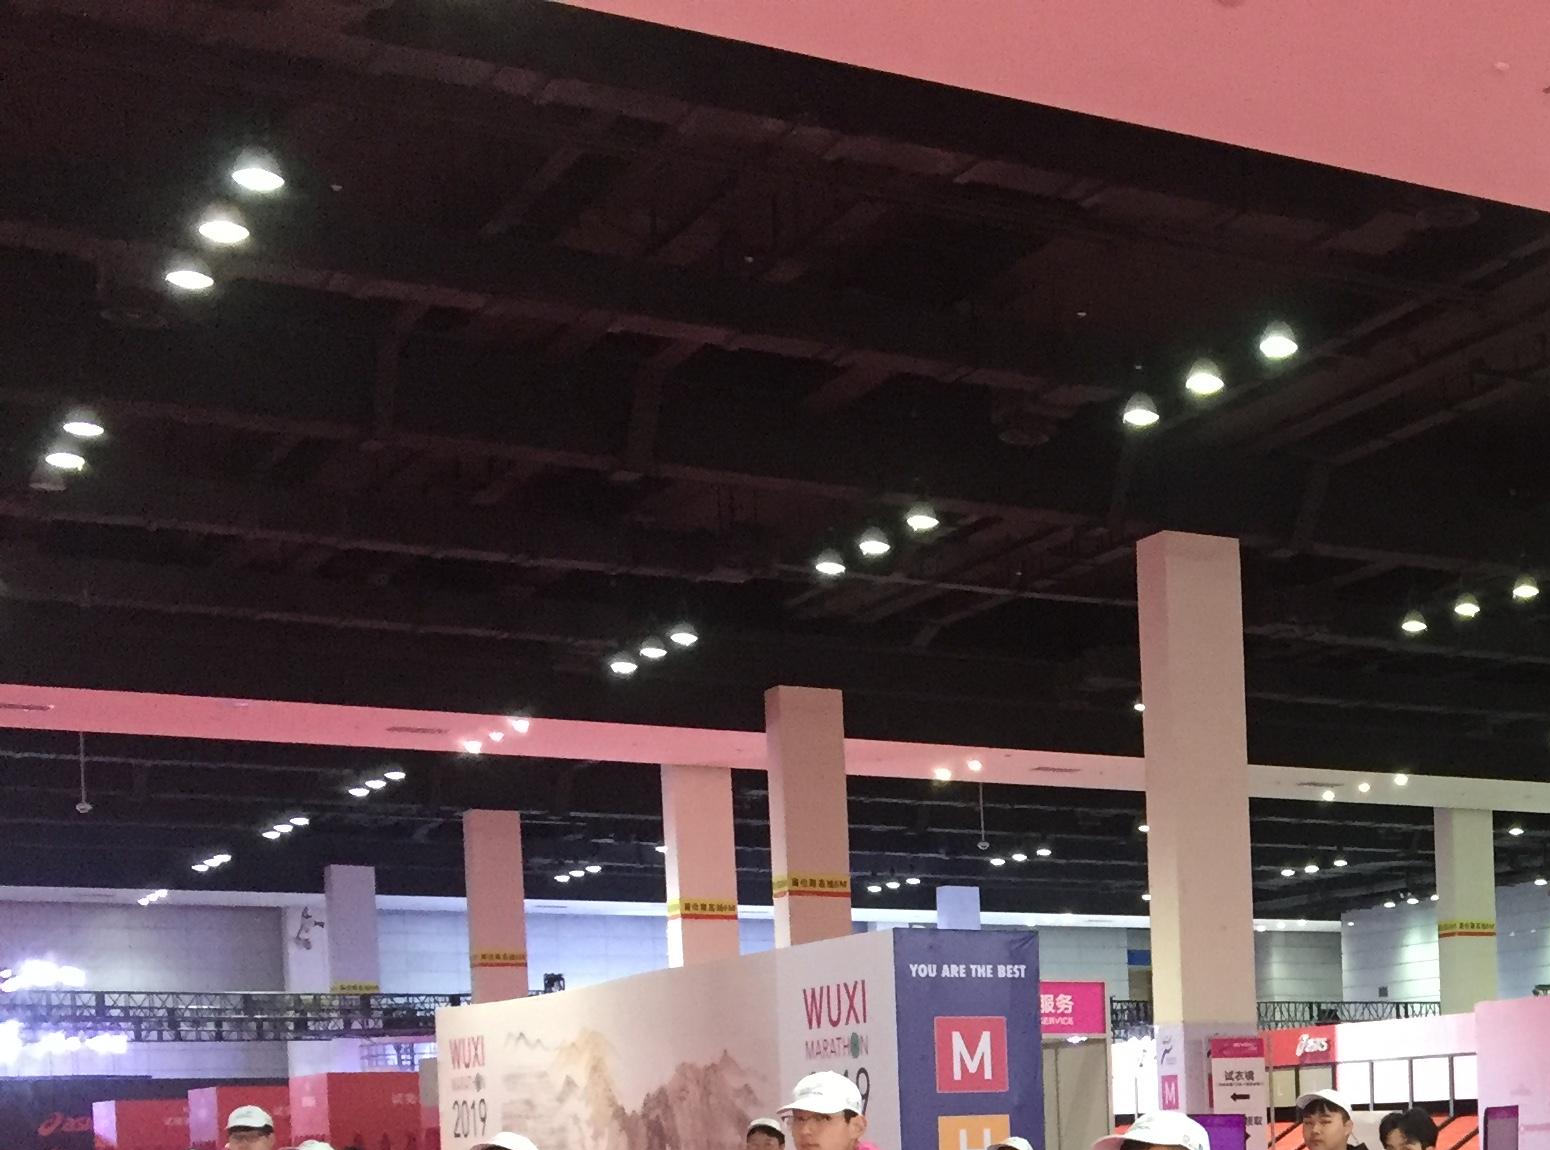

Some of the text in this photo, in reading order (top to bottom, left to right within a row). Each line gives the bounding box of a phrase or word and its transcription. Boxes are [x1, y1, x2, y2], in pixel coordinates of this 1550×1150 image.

[909, 964, 1027, 979] YOU ARE THE BEST
[803, 979, 868, 1030] WUXI
[450, 1035, 485, 1069] WUXI
[952, 1031, 993, 1080] M
[453, 1098, 488, 1139] 2019
